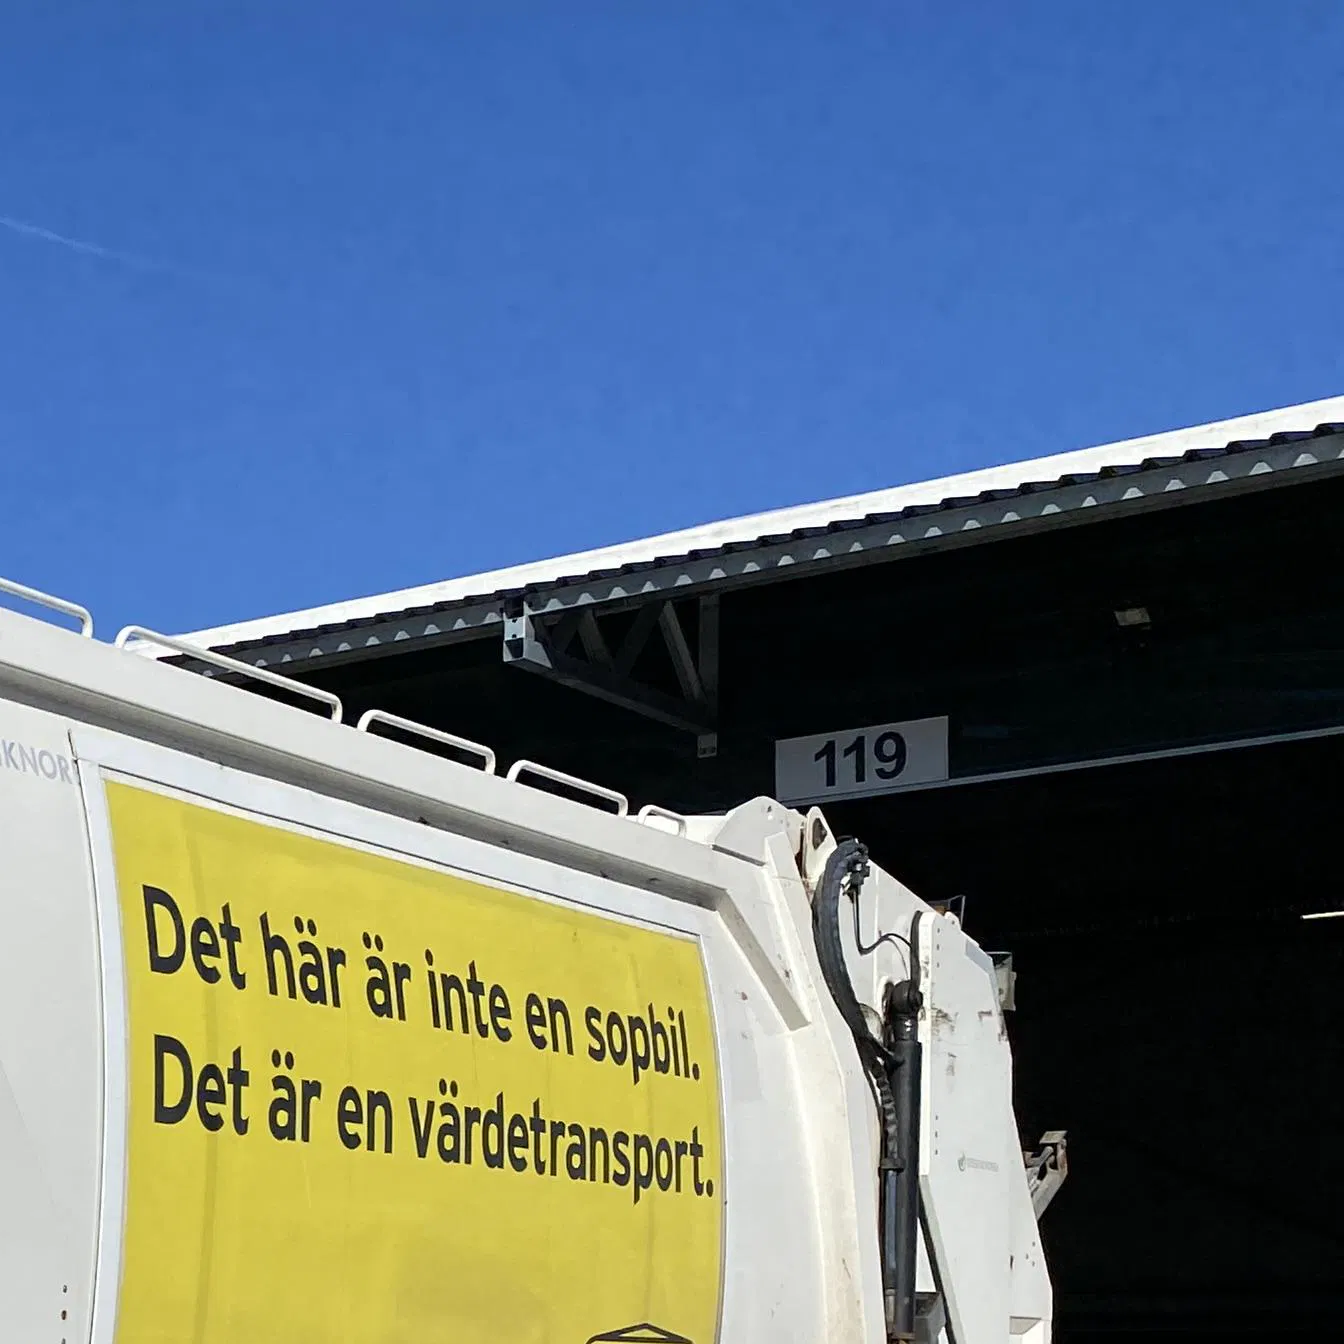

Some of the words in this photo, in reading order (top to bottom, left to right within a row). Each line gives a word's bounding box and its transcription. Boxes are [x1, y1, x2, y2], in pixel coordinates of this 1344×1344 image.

[814, 731, 907, 787] 119
[142, 884, 246, 990] Det
[260, 911, 346, 1009] här
[362, 932, 411, 1021] är
[425, 949, 512, 1043] inte
[526, 991, 574, 1056] en
[586, 1003, 701, 1085] sopbil.
[153, 1034, 250, 1135] Det
[268, 1048, 321, 1142] är
[337, 1085, 393, 1154] en
[408, 1078, 714, 1205] värdetransport.
